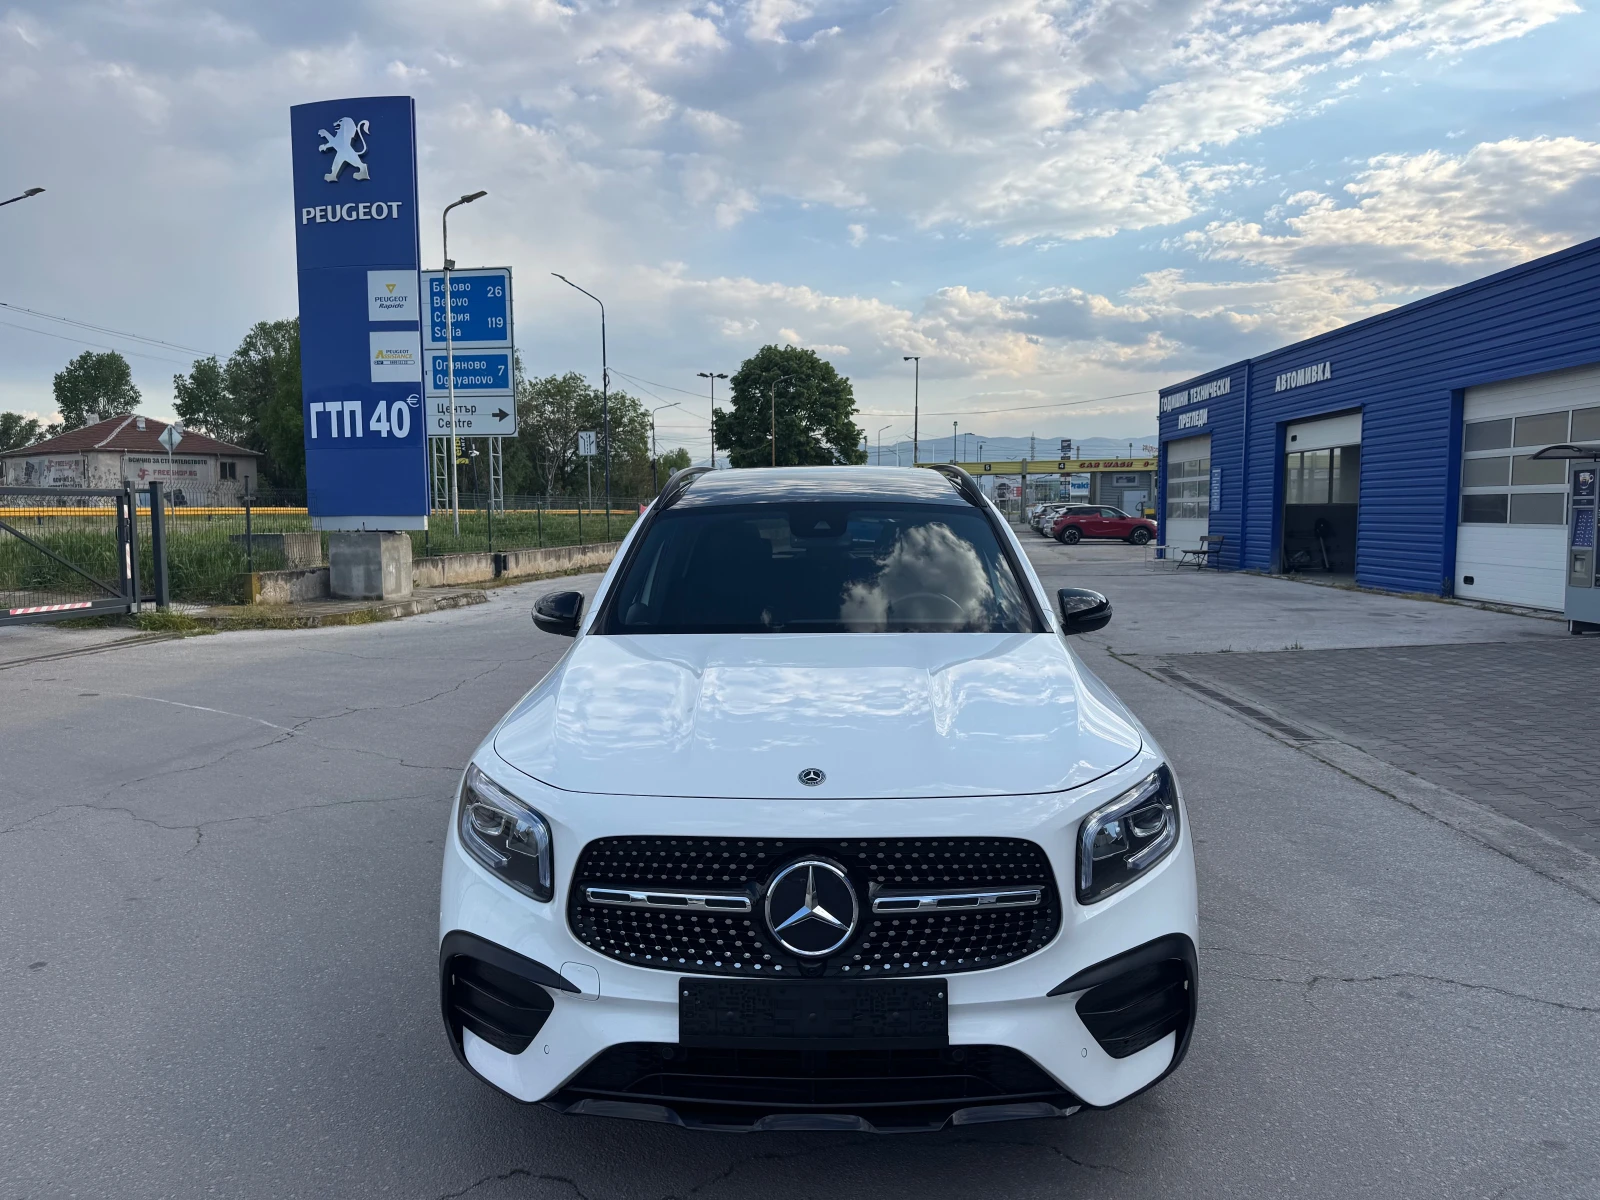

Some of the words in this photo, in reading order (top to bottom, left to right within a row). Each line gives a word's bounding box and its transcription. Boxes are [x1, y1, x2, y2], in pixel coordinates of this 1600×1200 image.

[302, 202, 402, 225] PEUGEOT
[487, 286, 502, 297] 26
[433, 296, 468, 307] Beovo
[487, 317, 504, 328] 119
[434, 326, 462, 337] Soia
[498, 365, 505, 376] 7
[1275, 361, 1331, 392] АВТОМИВКА
[1160, 390, 1189, 412] ГОДИШНИ
[1190, 376, 1231, 403] ТЕХНИЧЕСКИ
[310, 400, 363, 438] ГТП
[1178, 408, 1208, 429] ПРЕГЛЕДИ
[1079, 461, 1100, 469] CAR
